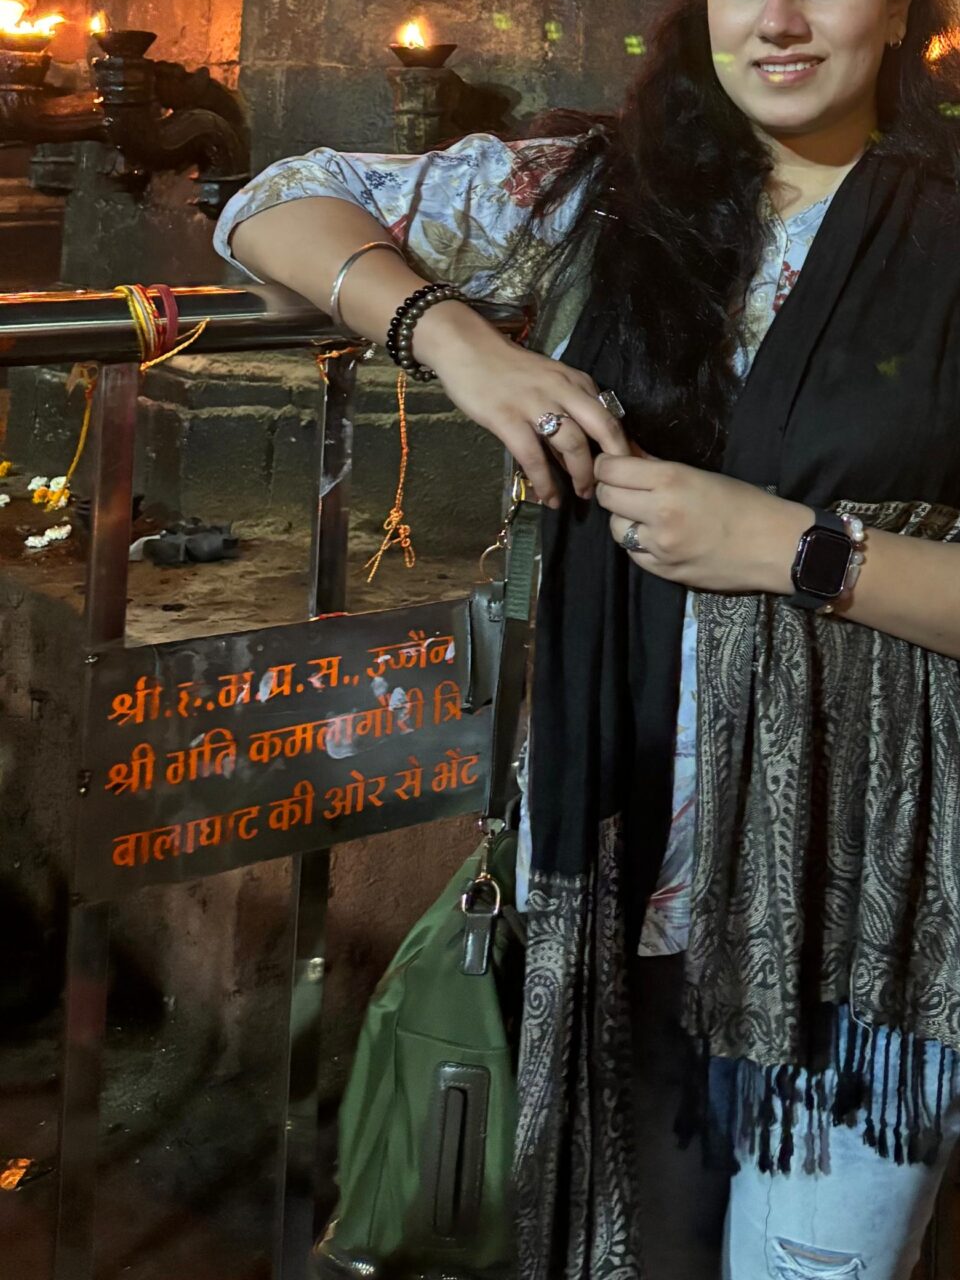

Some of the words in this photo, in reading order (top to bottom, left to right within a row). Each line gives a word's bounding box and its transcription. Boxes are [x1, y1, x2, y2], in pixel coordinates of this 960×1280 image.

[105, 742, 156, 796] श्री
[268, 780, 316, 832] की
[323, 770, 388, 820] ओर
[394, 754, 424, 801] से
